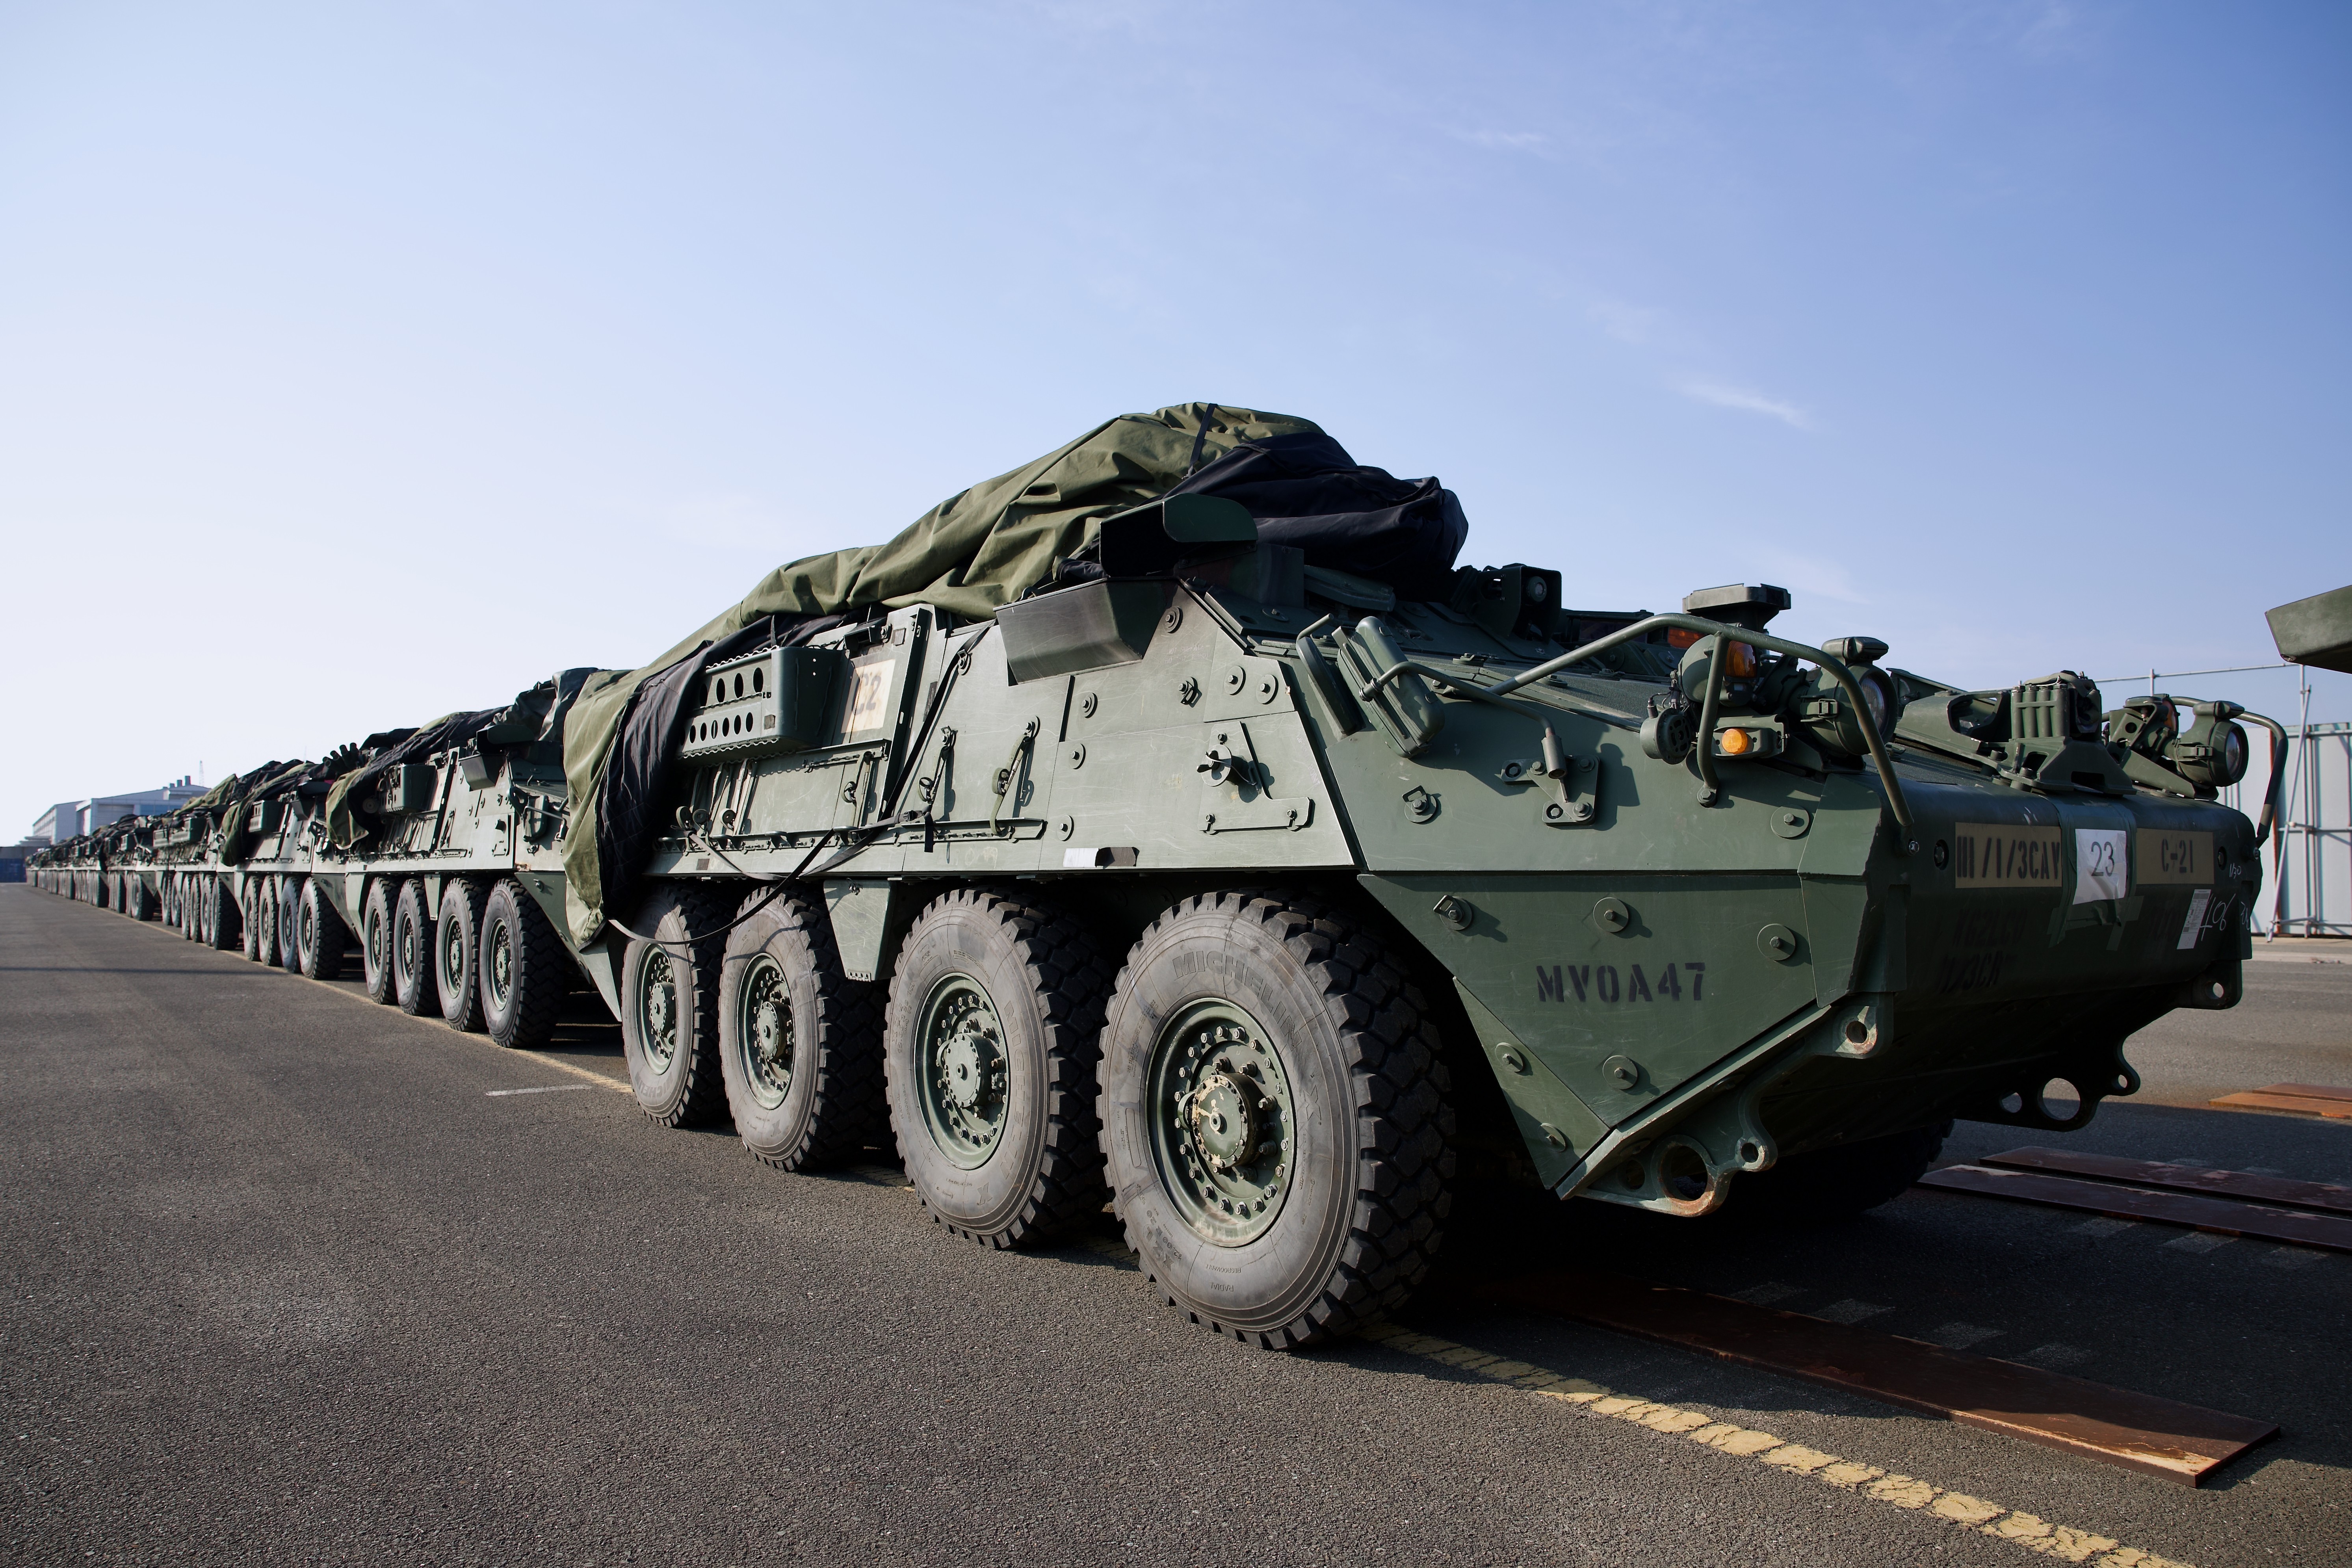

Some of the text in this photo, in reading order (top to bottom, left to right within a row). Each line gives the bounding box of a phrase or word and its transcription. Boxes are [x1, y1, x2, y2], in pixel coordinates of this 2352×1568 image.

[2090, 841, 2115, 877] 23
[2161, 839, 2194, 873] C-21
[1172, 950, 1302, 1051] MICHELIN
[635, 1071, 673, 1098] MICHELIN
[1000, 1001, 1024, 1180] MICHELIN
[1146, 1209, 1182, 1261] 12.00 R 20
[1204, 1264, 1241, 1274] REGROOVABLE
[1210, 1282, 1234, 1291] RADIAL
